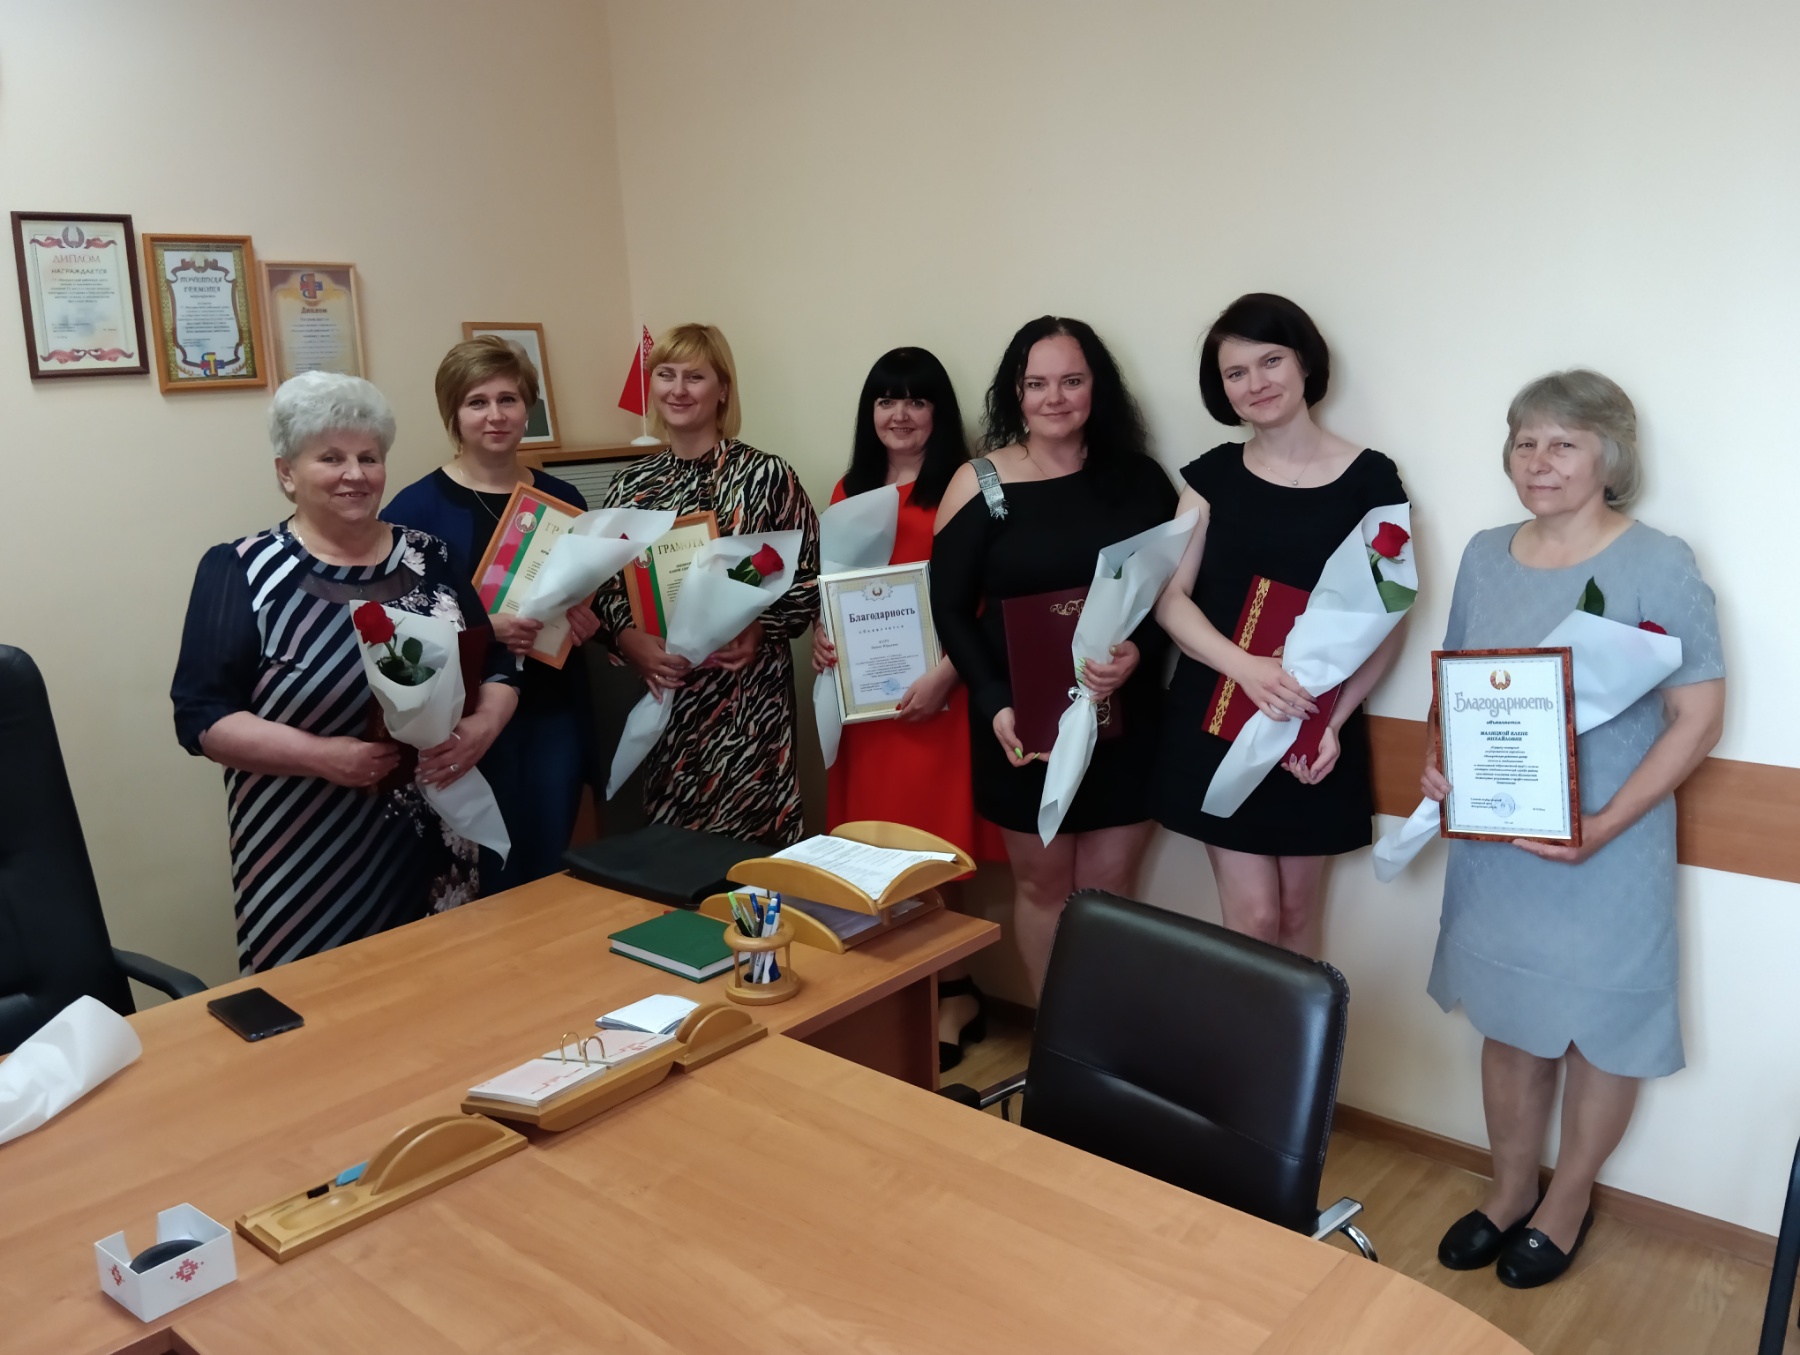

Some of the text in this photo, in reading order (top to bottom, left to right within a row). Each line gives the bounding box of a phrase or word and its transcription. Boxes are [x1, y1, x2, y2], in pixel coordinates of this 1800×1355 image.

[53, 255, 101, 263] ДИПЛОМ
[849, 608, 916, 623] Благодарность
[1453, 692, 1554, 718] Благодарность
